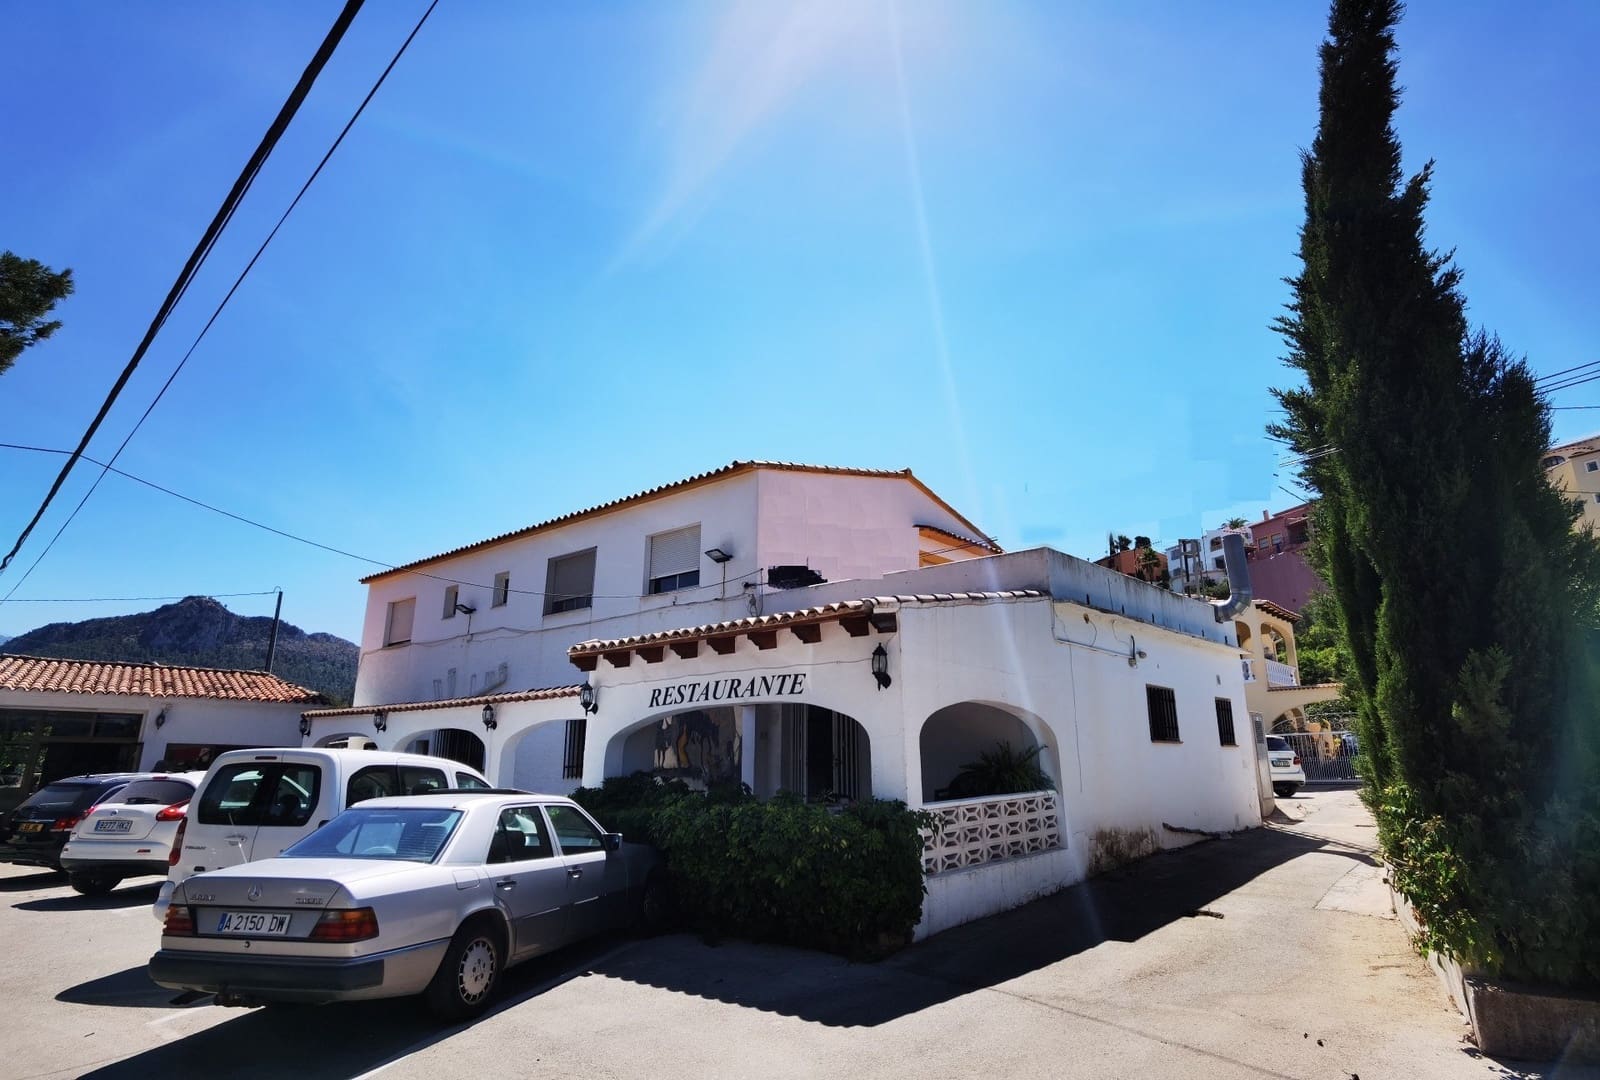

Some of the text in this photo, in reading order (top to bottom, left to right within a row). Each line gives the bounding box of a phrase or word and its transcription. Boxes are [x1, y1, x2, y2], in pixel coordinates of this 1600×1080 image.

[648, 673, 806, 707] RESTAURANTE
[223, 915, 287, 932] A 2150 DW
